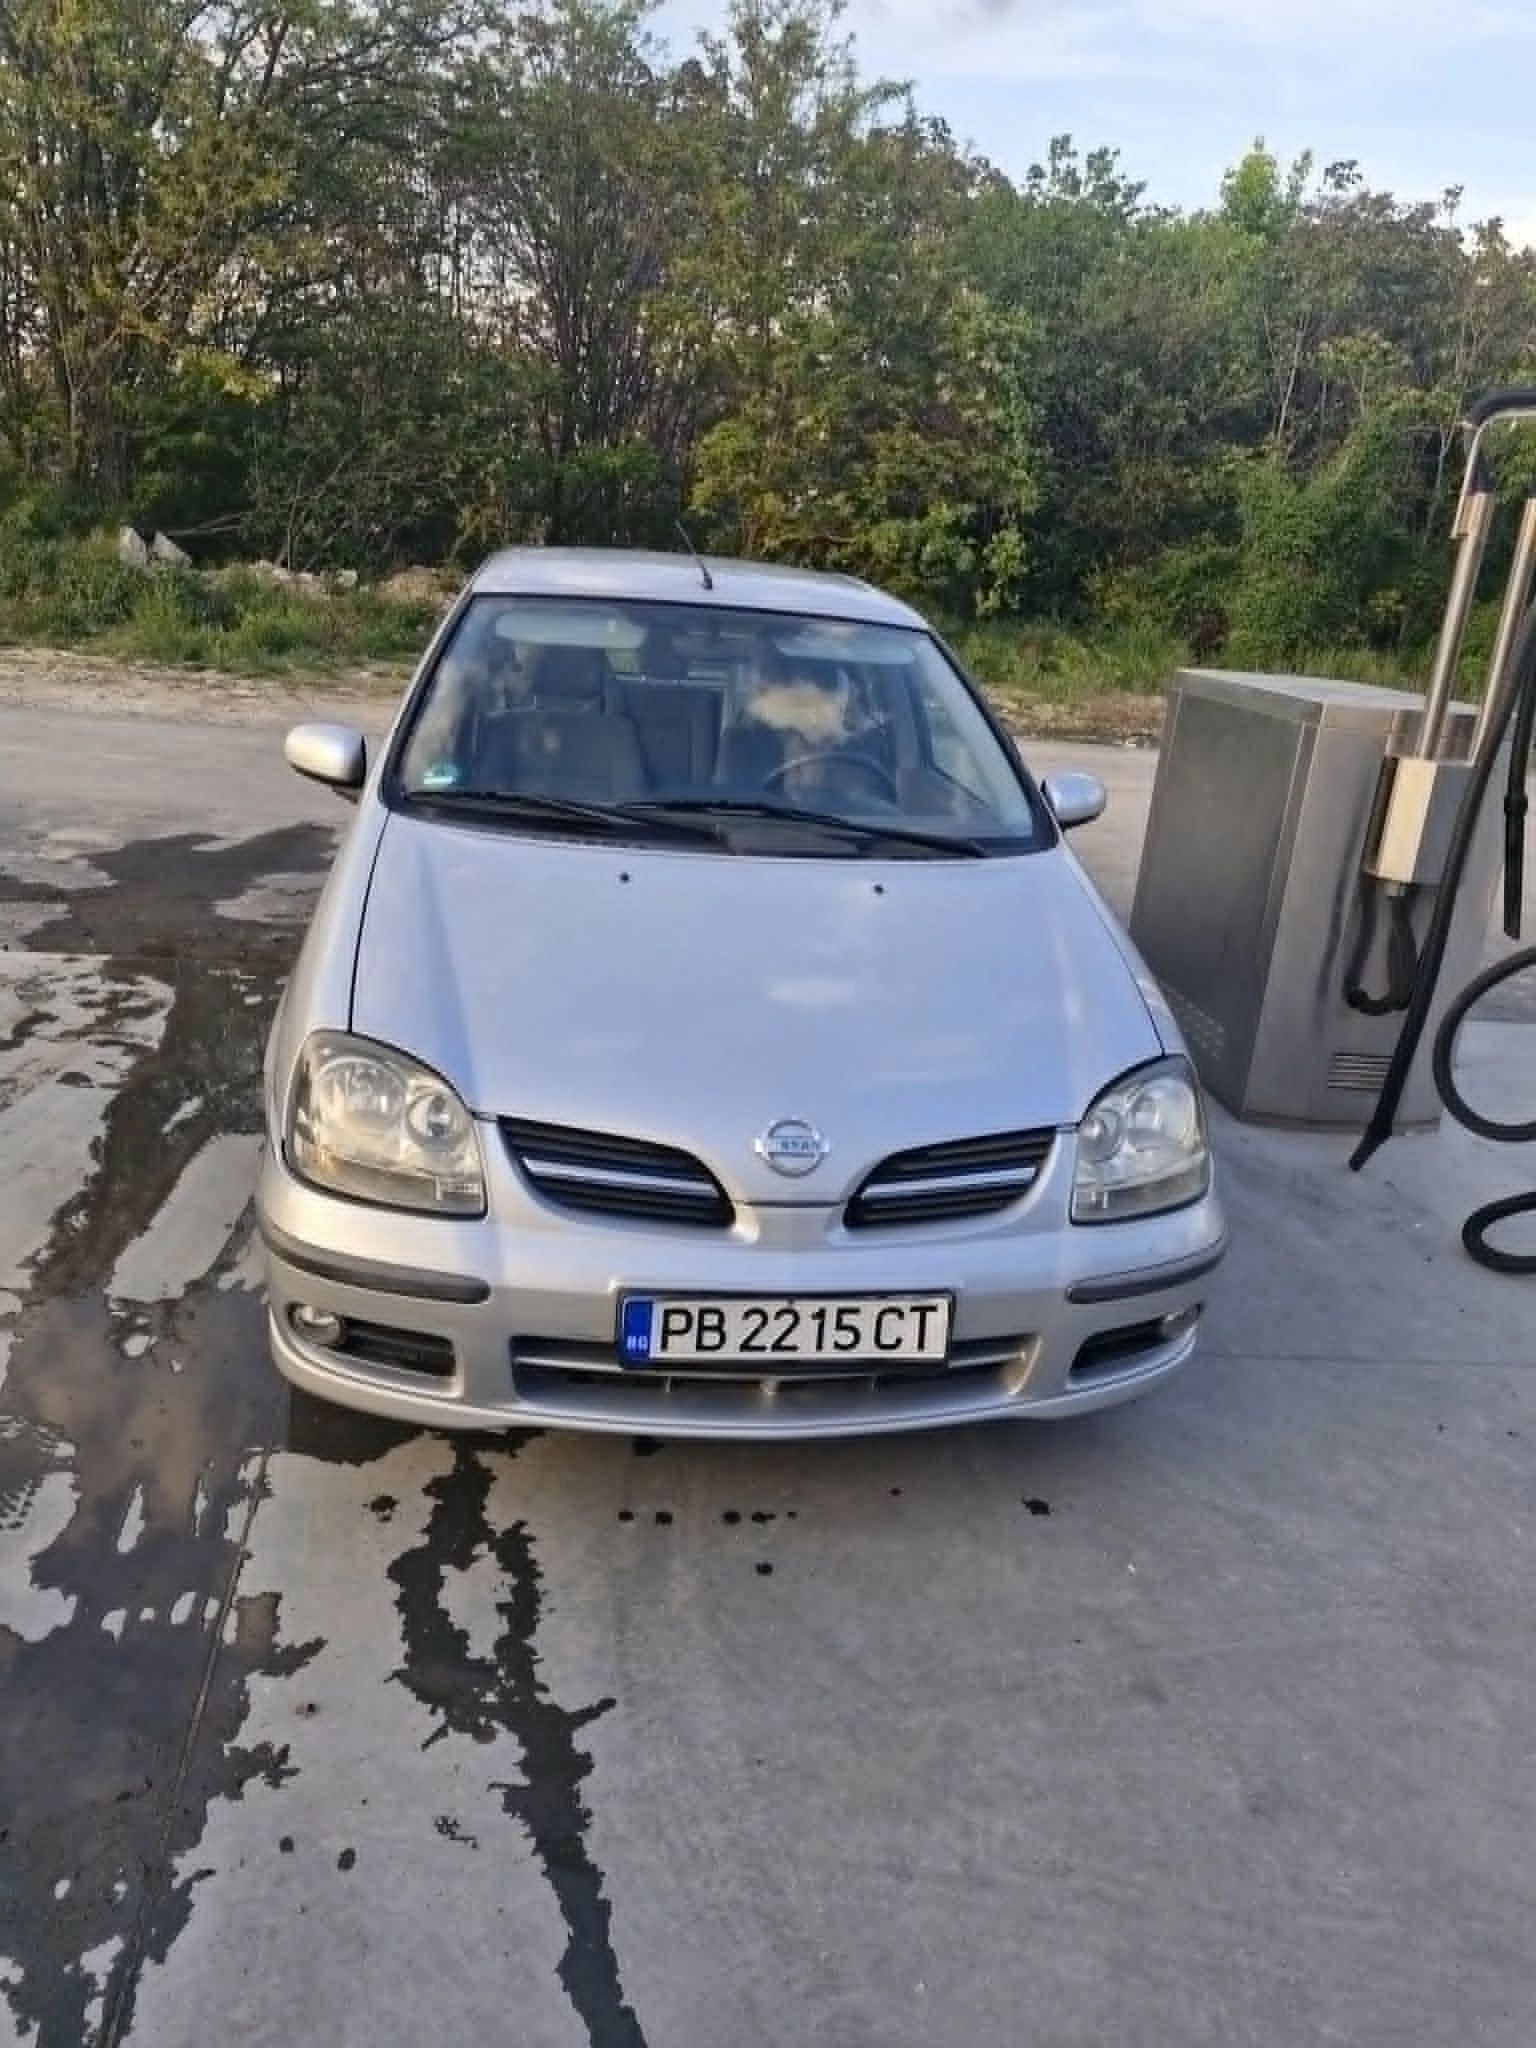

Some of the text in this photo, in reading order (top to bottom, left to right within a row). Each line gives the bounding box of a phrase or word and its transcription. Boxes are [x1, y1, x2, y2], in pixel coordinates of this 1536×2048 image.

[660, 1306, 938, 1351] PB 2215 CT
